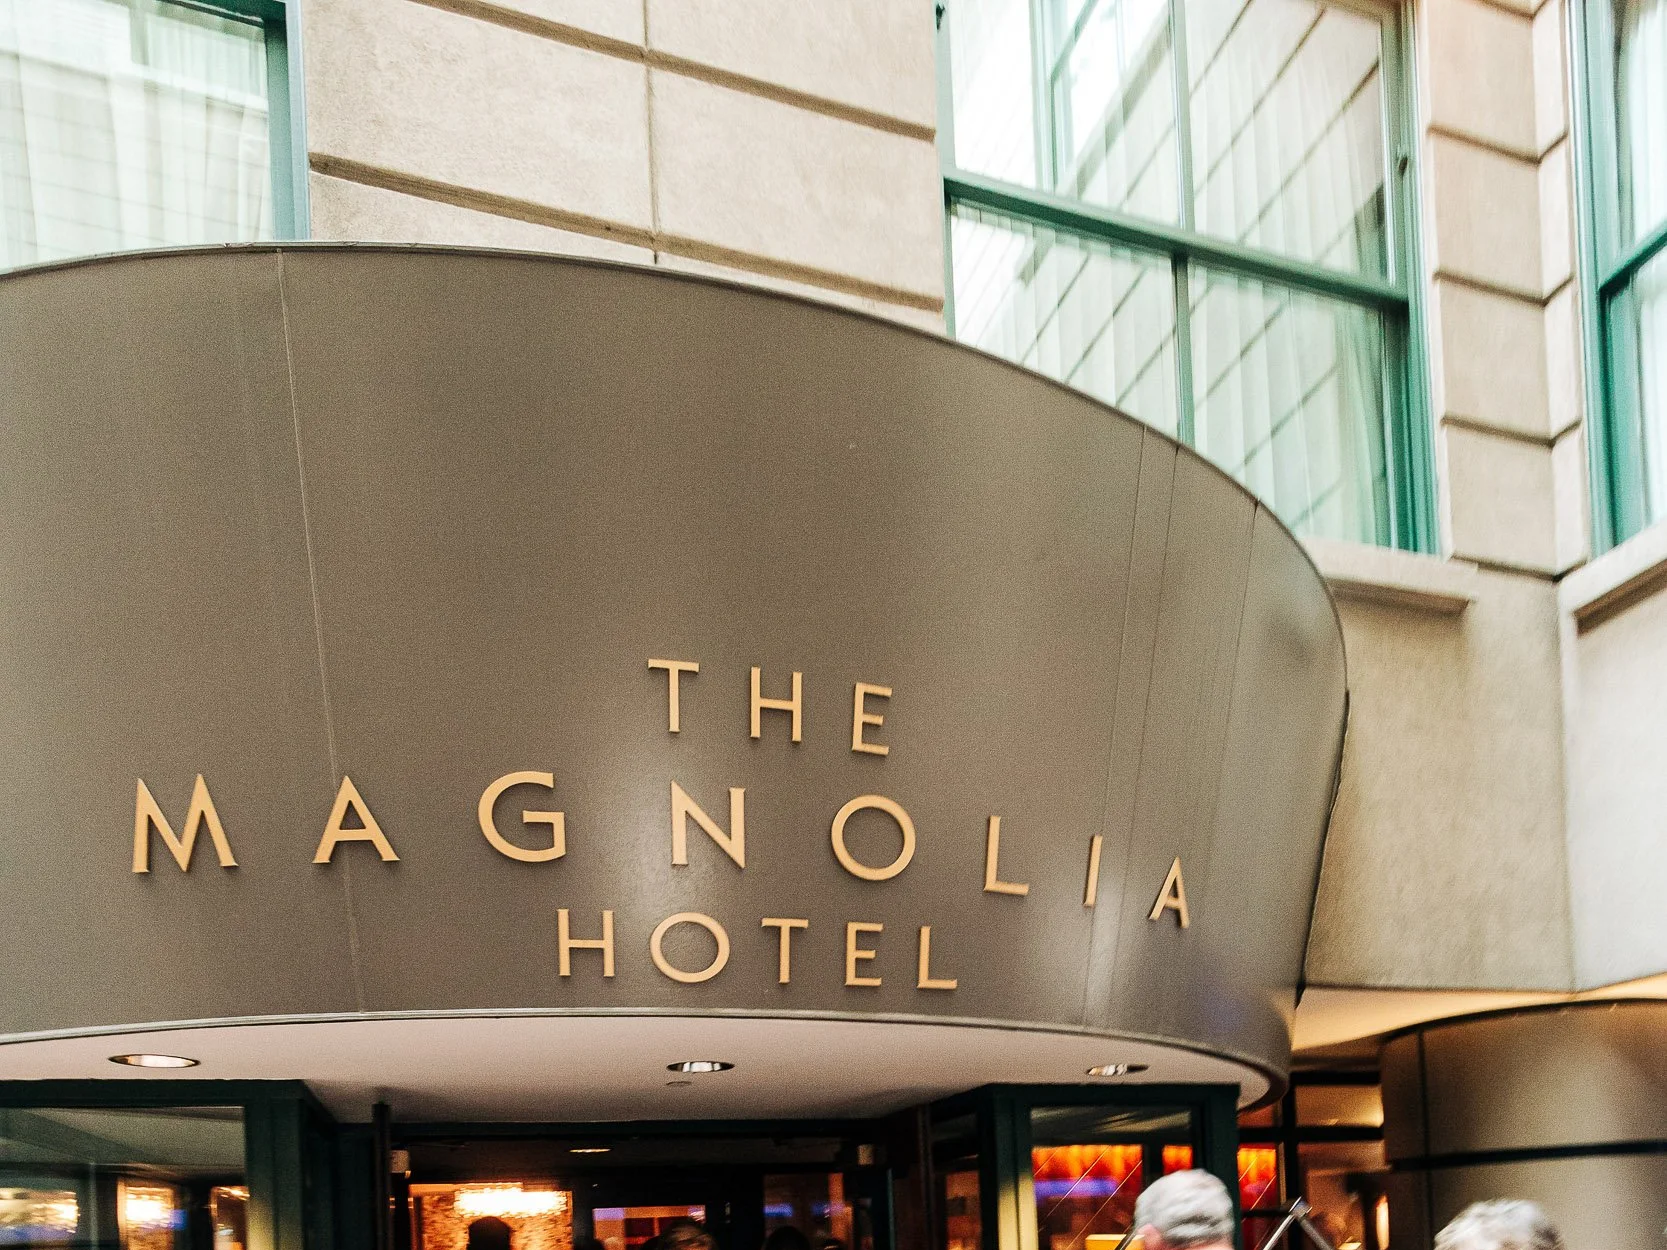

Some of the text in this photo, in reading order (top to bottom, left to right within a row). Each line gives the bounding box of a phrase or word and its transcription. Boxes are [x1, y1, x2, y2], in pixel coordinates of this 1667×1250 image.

[646, 656, 894, 757] THE
[130, 769, 1191, 930] MAGNOLIA
[555, 906, 960, 992] HOTEL
